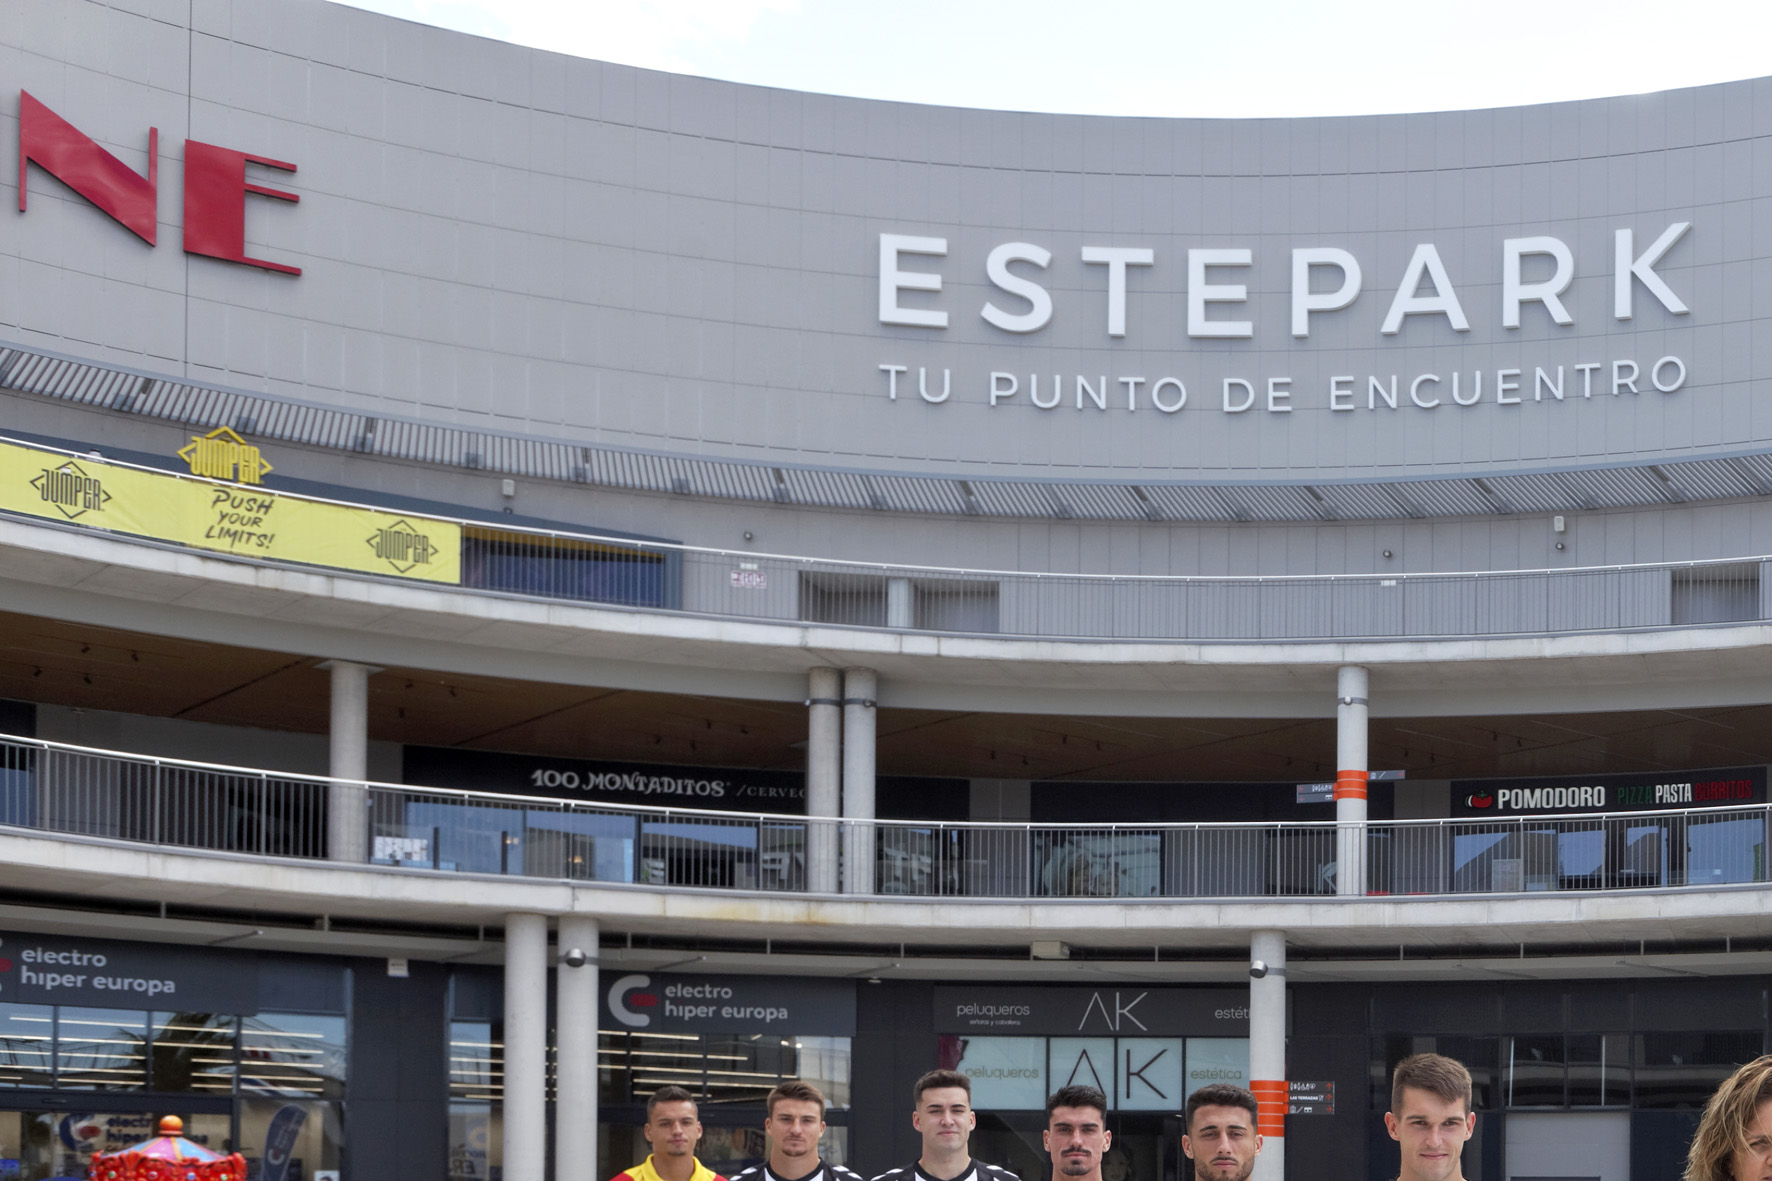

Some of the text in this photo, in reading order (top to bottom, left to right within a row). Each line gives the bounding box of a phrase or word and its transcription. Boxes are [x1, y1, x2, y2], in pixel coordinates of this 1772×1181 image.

[878, 221, 1691, 339] ESTEPARK
[879, 355, 1688, 413] TU PUNTO DE ENCUENTRO
[190, 435, 261, 484] JUMPER
[40, 468, 102, 512] JUMPER
[211, 488, 274, 516] PUSH
[217, 512, 263, 529] YOUR
[204, 523, 276, 550] LIMITS!
[375, 528, 429, 564] JUMPER
[530, 768, 580, 790] 100
[582, 770, 726, 798] MONTADITOS
[1497, 779, 1753, 811] POMODORO PIZZA PASTA BURRITOS
[21, 947, 108, 968] electro
[20, 965, 176, 997] hiper europa
[664, 982, 733, 999] electro
[664, 1000, 788, 1023] hiper europa
[956, 1002, 1031, 1018] peluqueros
[1078, 991, 1148, 1031] AK
[964, 1066, 1040, 1081] peluqueros
[1190, 1065, 1242, 1080] estética
